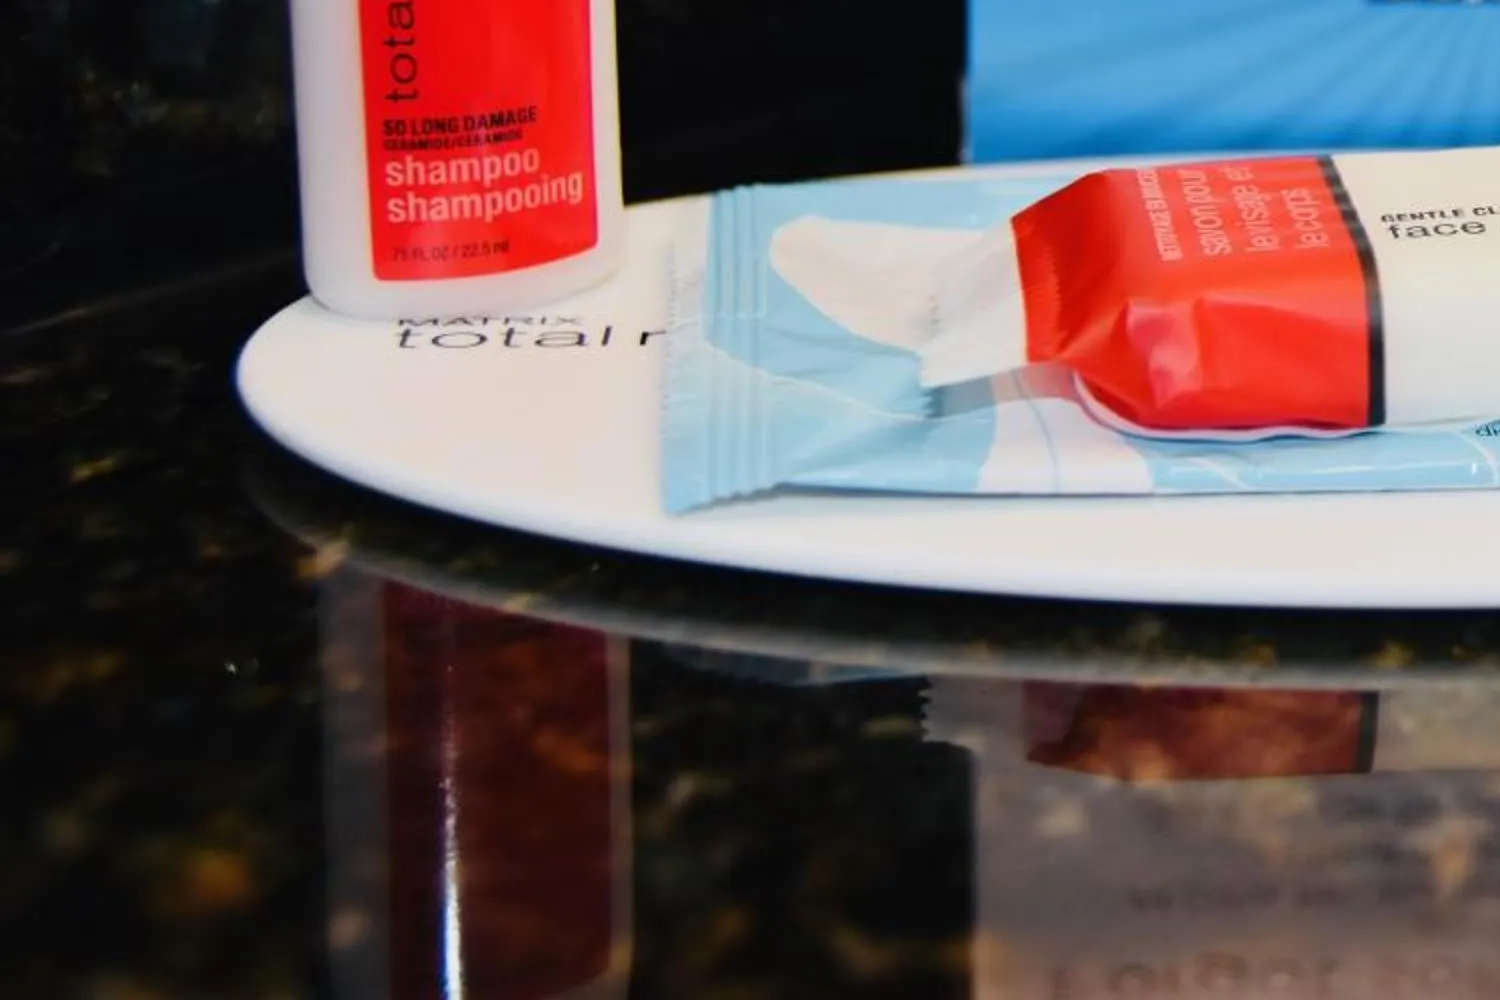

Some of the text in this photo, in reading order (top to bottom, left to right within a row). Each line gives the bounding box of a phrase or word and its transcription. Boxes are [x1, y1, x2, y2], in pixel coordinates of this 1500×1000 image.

[383, 105, 538, 137] SO LONG DAMAGE
[385, 147, 540, 188] shampoo
[386, 171, 584, 224] shampooing
[1190, 204, 1233, 257] savon
[1381, 206, 1465, 223] GENTLE
[1387, 217, 1486, 240] face
[398, 325, 613, 349] total
